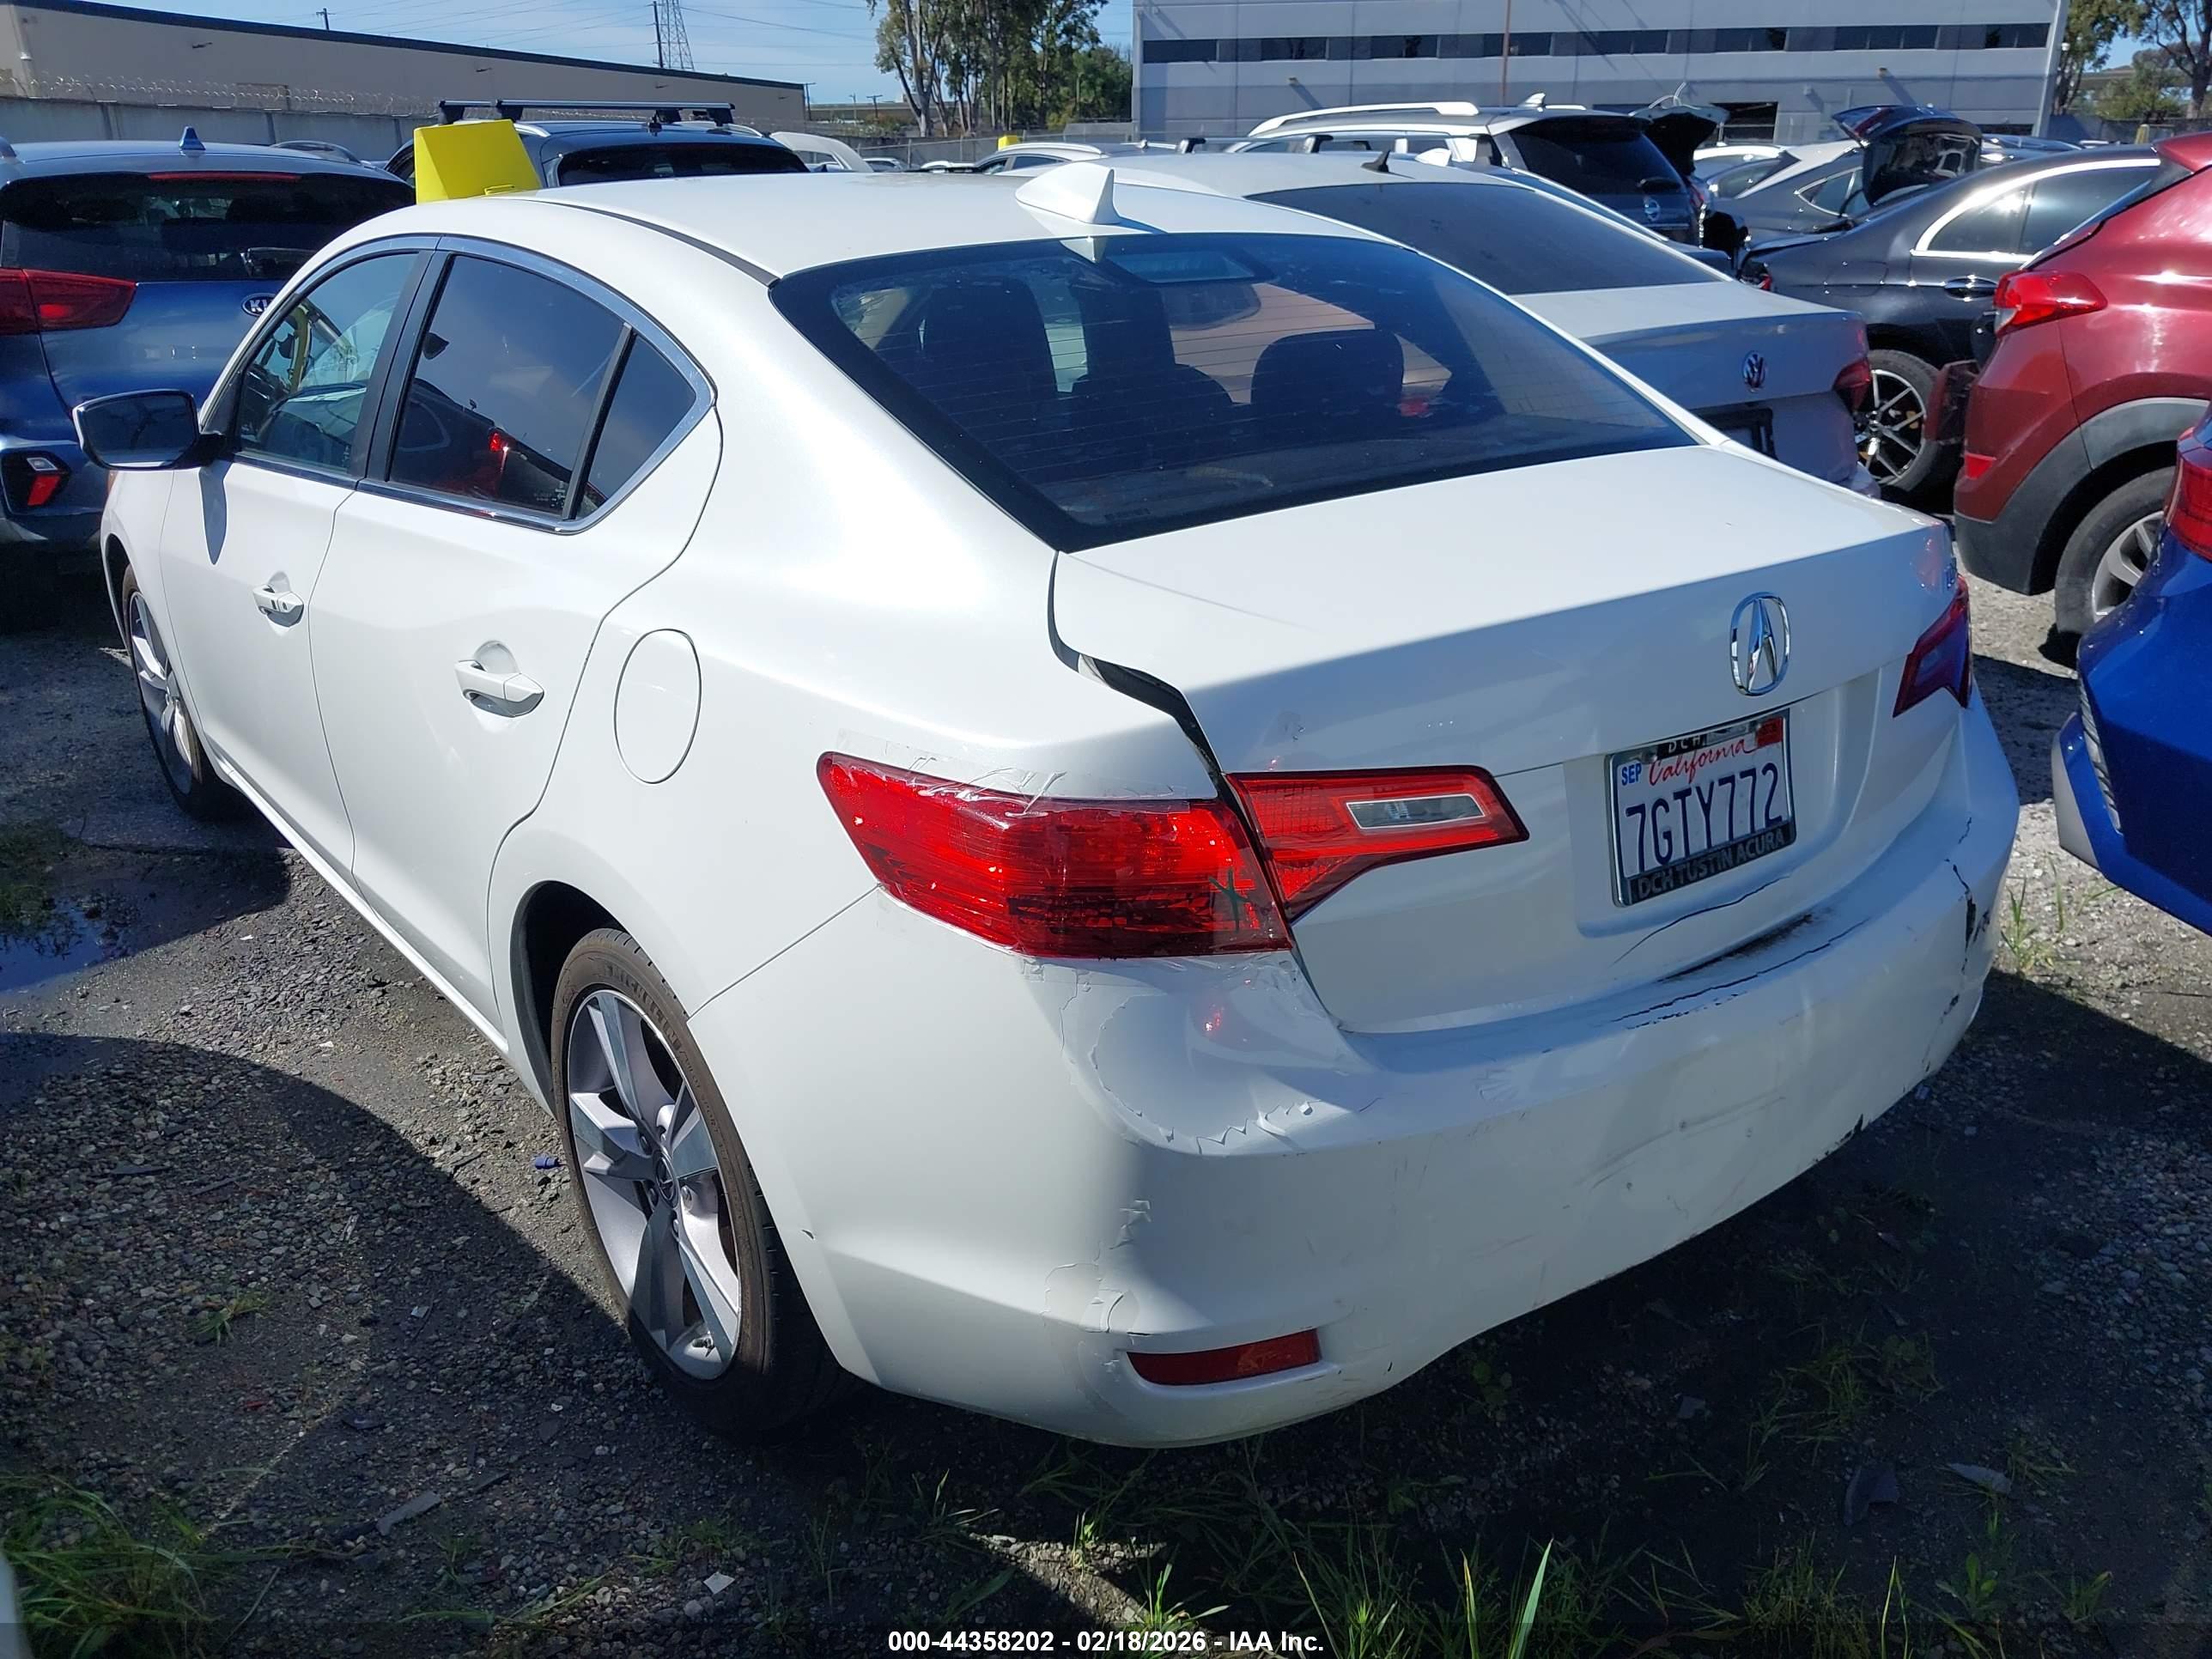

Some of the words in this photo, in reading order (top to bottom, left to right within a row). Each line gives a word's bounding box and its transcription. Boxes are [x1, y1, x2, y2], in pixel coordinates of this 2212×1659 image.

[1649, 740, 1757, 786] California
[1668, 738, 1703, 752] DCH
[1620, 762, 1642, 787] SEP
[1625, 762, 1784, 873] 7GTY772
[1638, 867, 1675, 899] DCH
[1676, 848, 1733, 884] TUSTIN
[1735, 828, 1786, 861] ACURA
